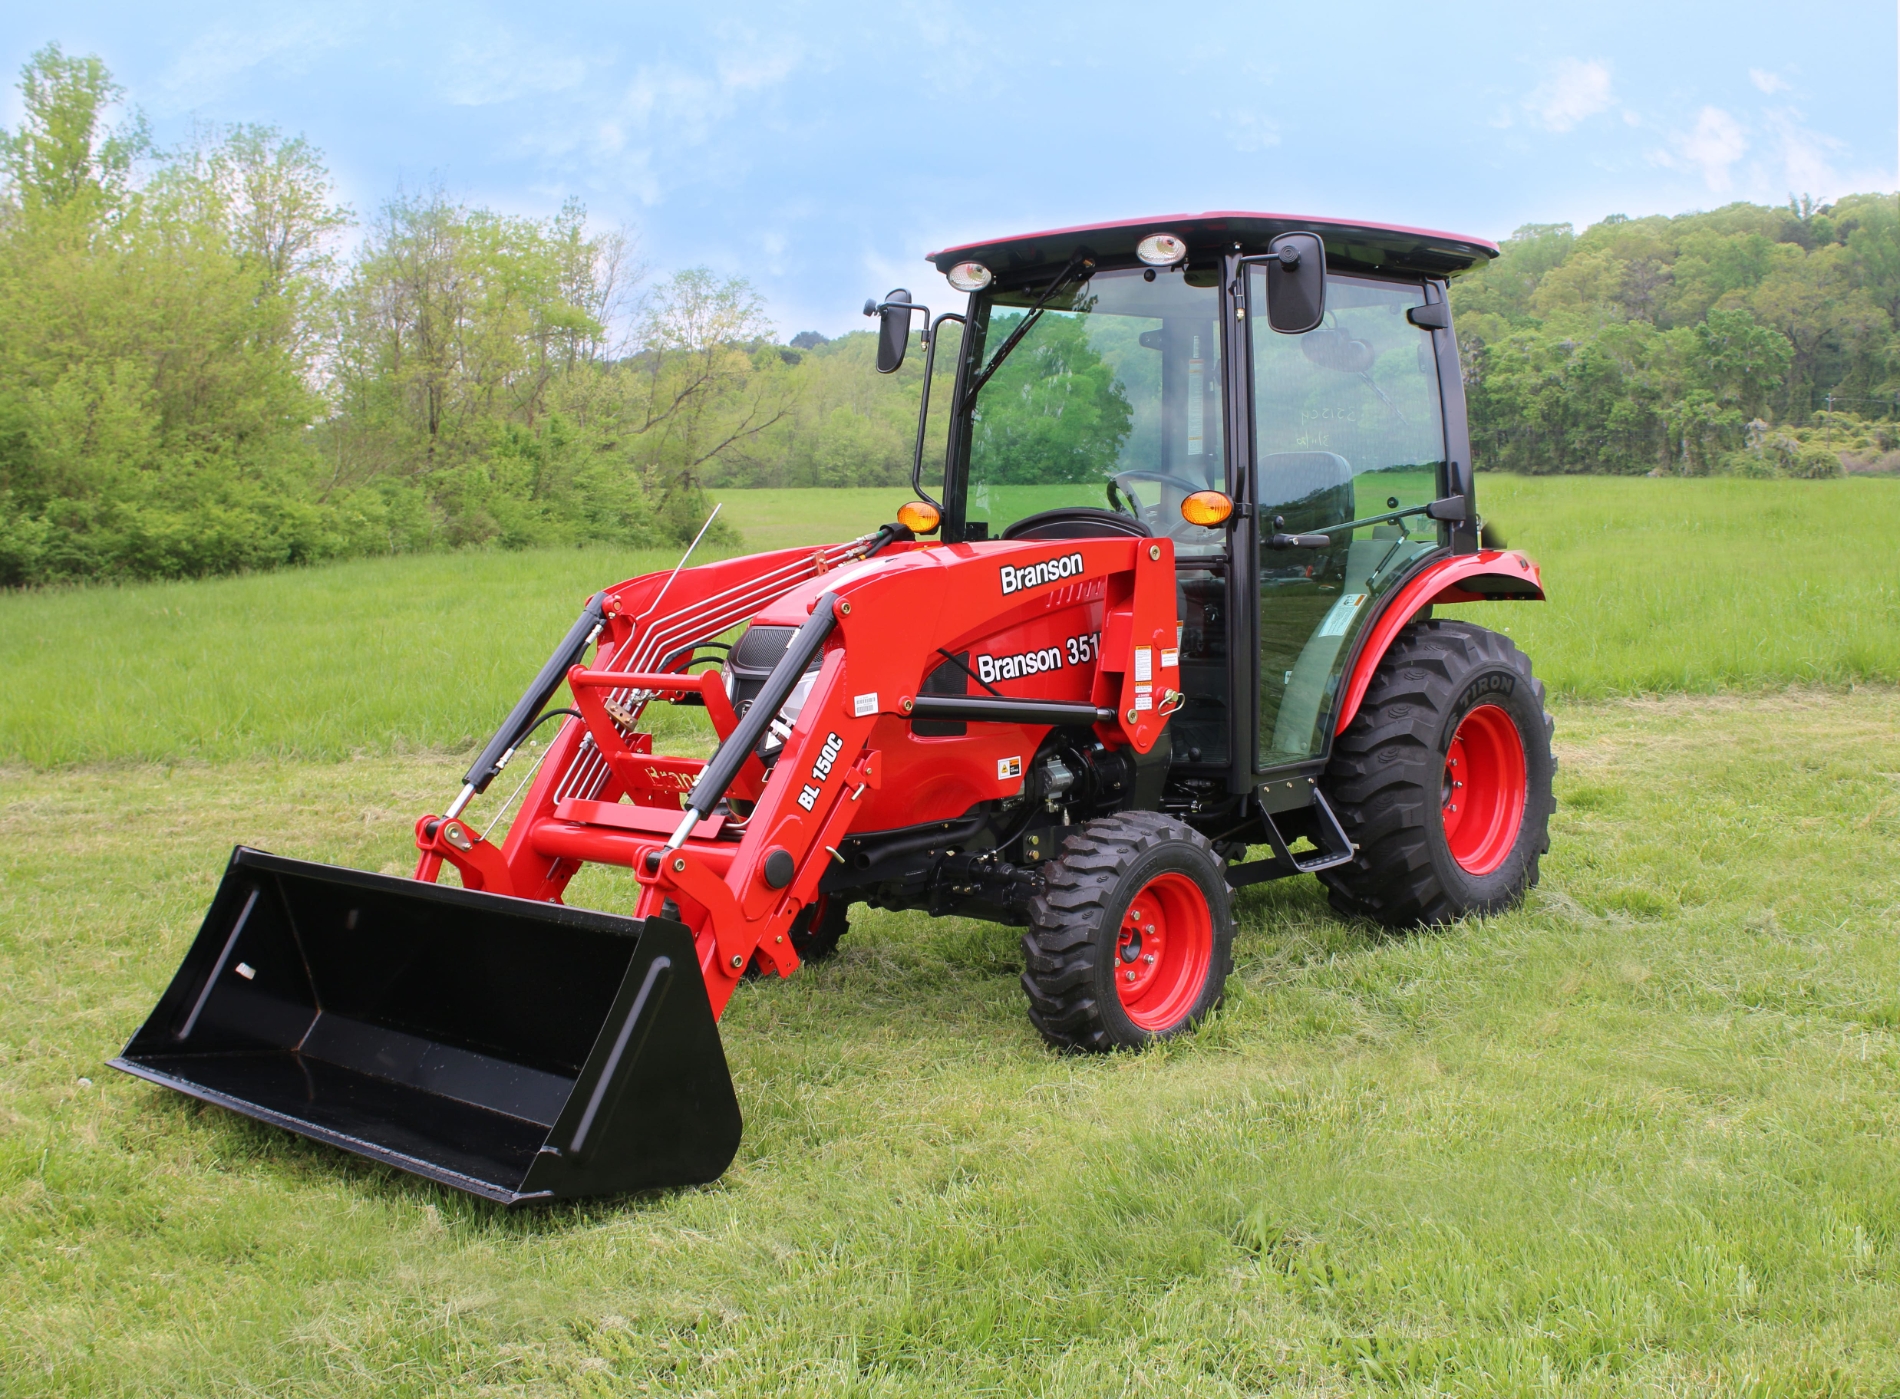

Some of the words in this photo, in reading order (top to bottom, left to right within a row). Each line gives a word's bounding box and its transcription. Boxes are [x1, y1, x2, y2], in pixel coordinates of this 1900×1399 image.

[1000, 552, 1084, 595] Branson
[977, 647, 1062, 684] Branson
[1066, 631, 1102, 666] 351
[1460, 675, 1513, 708] TIRON
[797, 783, 821, 813] BL
[812, 731, 844, 783] 150C
